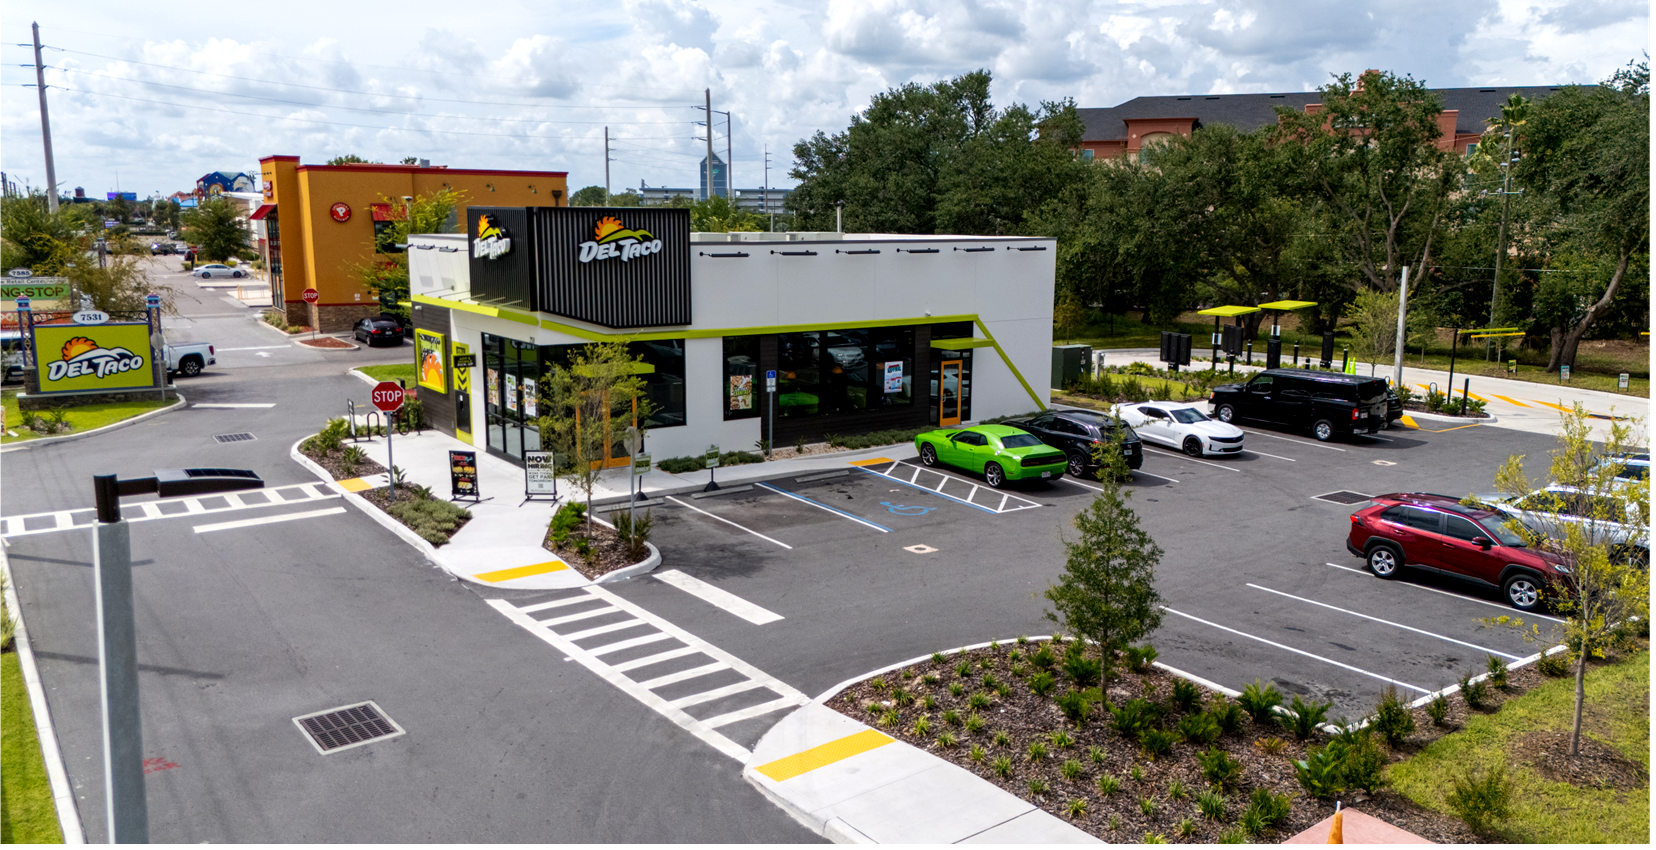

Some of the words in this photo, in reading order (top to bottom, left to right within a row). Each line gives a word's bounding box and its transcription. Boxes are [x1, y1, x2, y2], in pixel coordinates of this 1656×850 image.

[80, 313, 103, 321] 7531
[373, 390, 402, 402] STOP
[527, 455, 552, 463] NOW
